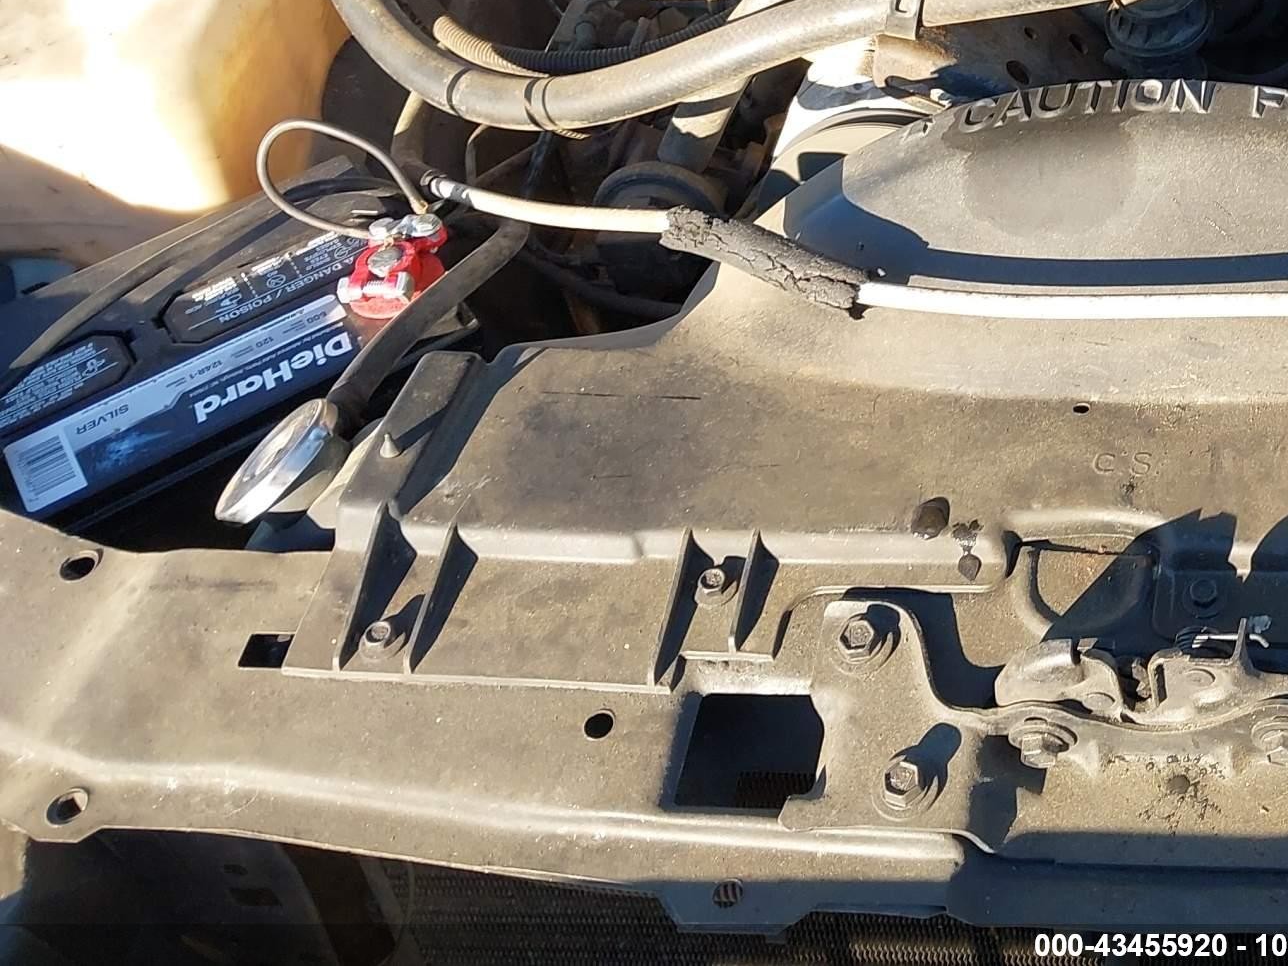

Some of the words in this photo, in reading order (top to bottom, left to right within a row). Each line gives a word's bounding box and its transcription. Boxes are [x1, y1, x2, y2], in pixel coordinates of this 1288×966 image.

[958, 79, 1216, 133] CAUTION
[284, 260, 342, 294] DANGER
[218, 293, 273, 325] POISON
[254, 335, 274, 349] 120
[190, 329, 355, 423] DieHard
[74, 402, 131, 436] SILVER
